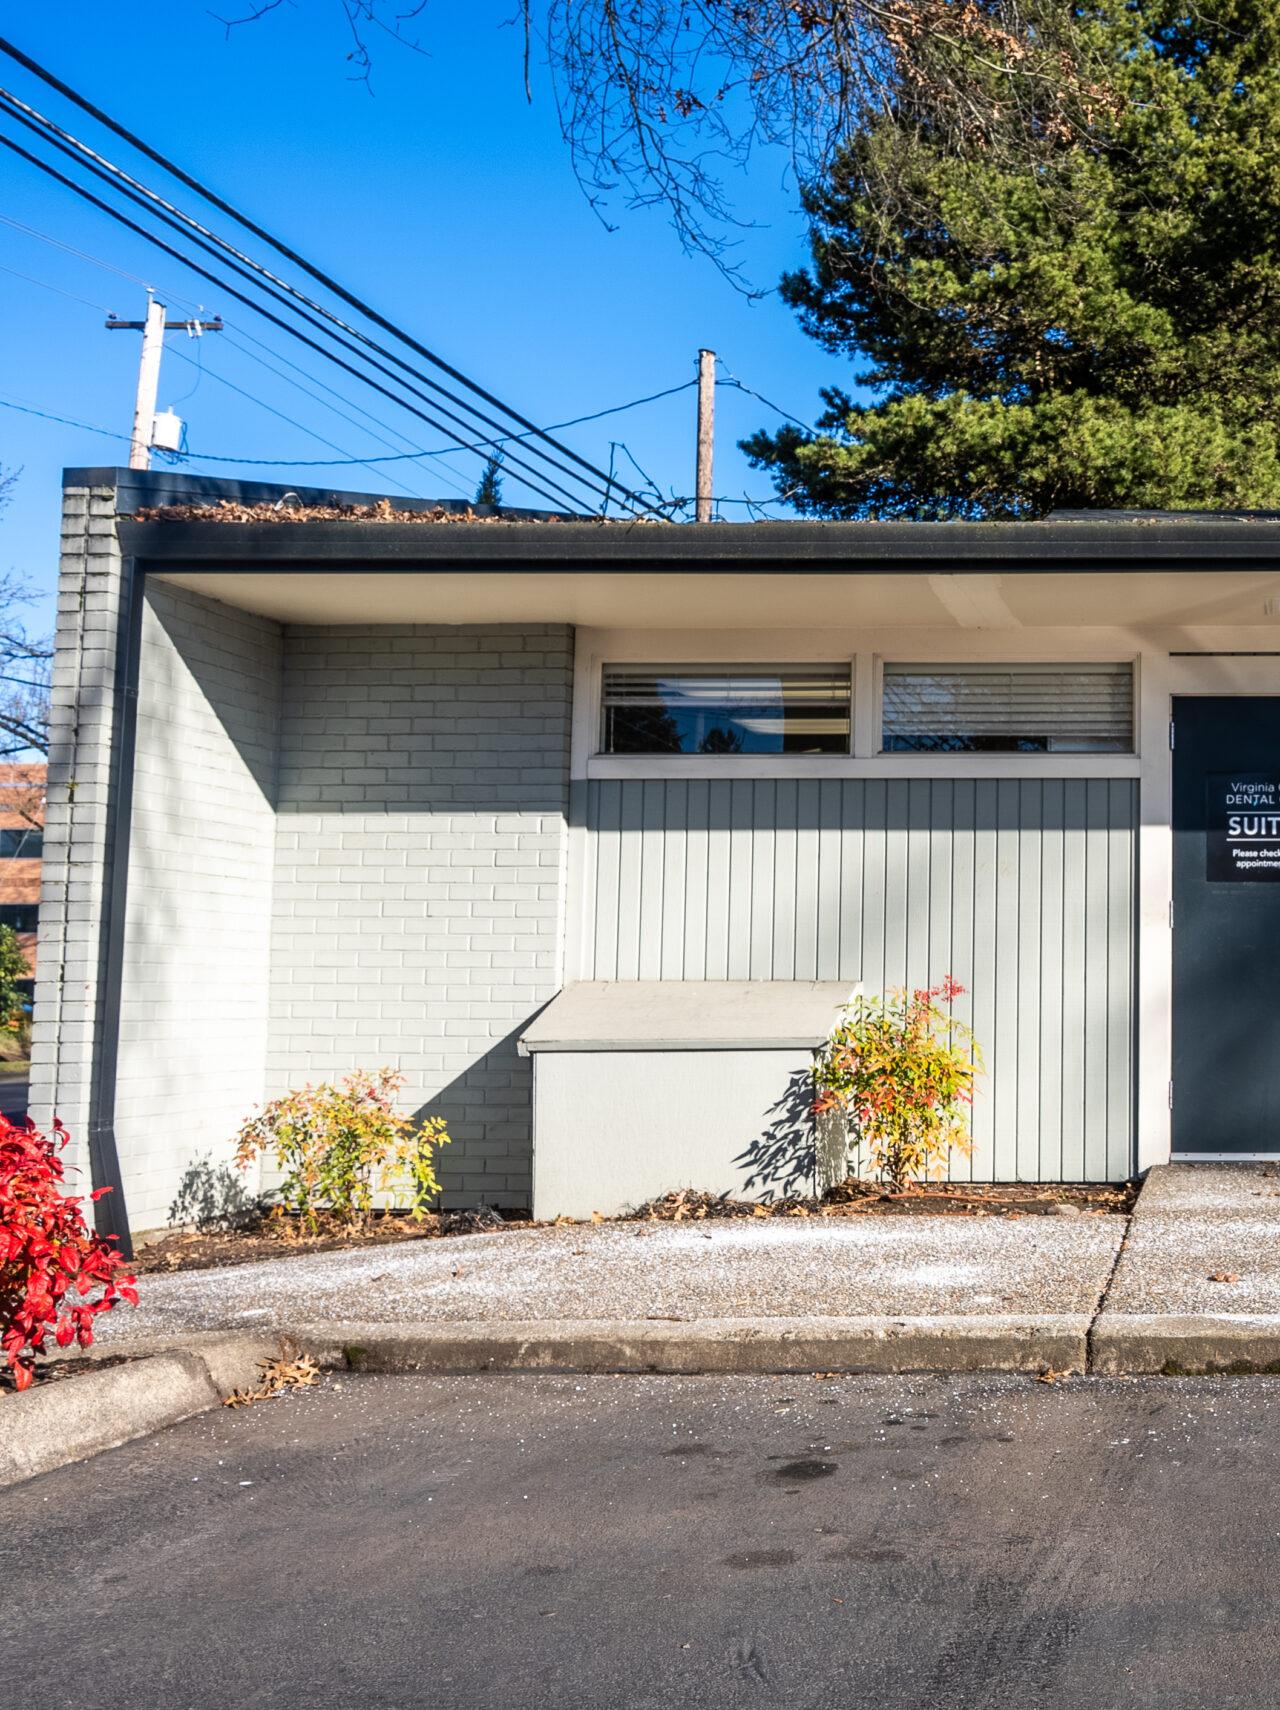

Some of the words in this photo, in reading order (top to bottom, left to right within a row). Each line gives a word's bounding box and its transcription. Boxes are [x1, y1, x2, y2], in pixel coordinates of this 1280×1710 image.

[1231, 782, 1275, 794] Virginia
[1226, 794, 1275, 805] DENTAL
[1232, 849, 1258, 857] Please
